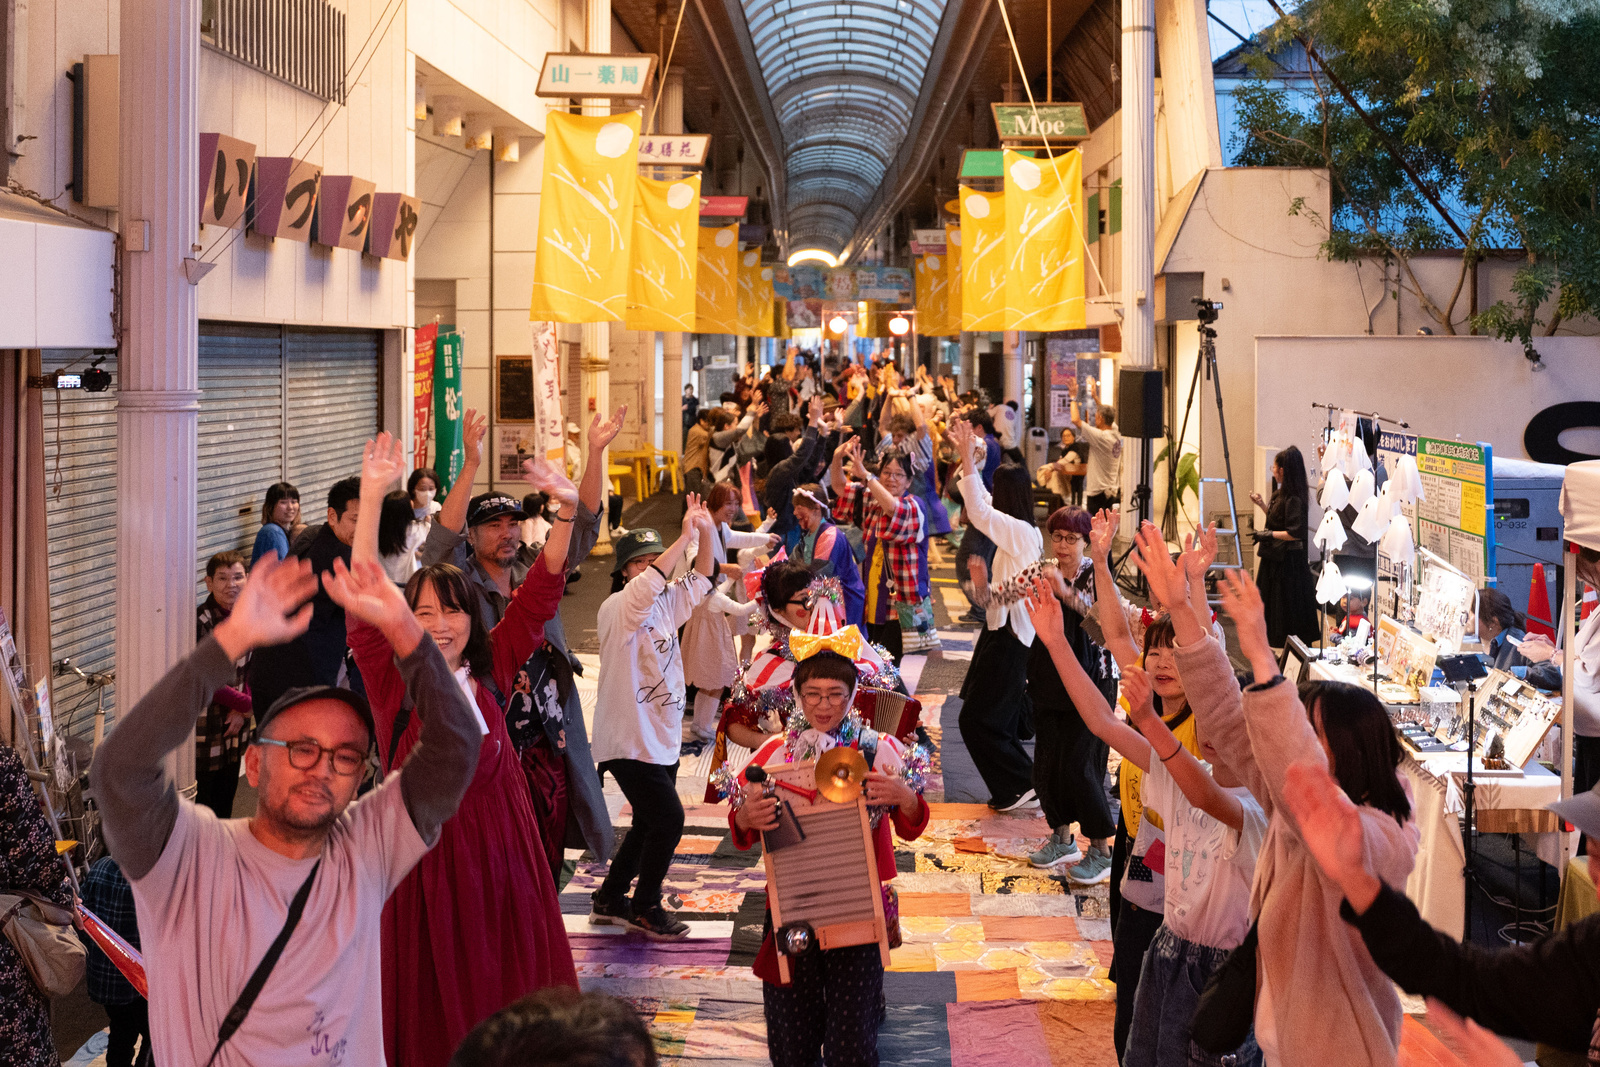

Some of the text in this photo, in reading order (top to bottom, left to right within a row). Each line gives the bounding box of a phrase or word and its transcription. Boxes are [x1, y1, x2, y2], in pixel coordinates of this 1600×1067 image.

[552, 64, 639, 85] 山一薬局
[1014, 115, 1066, 135] Moe
